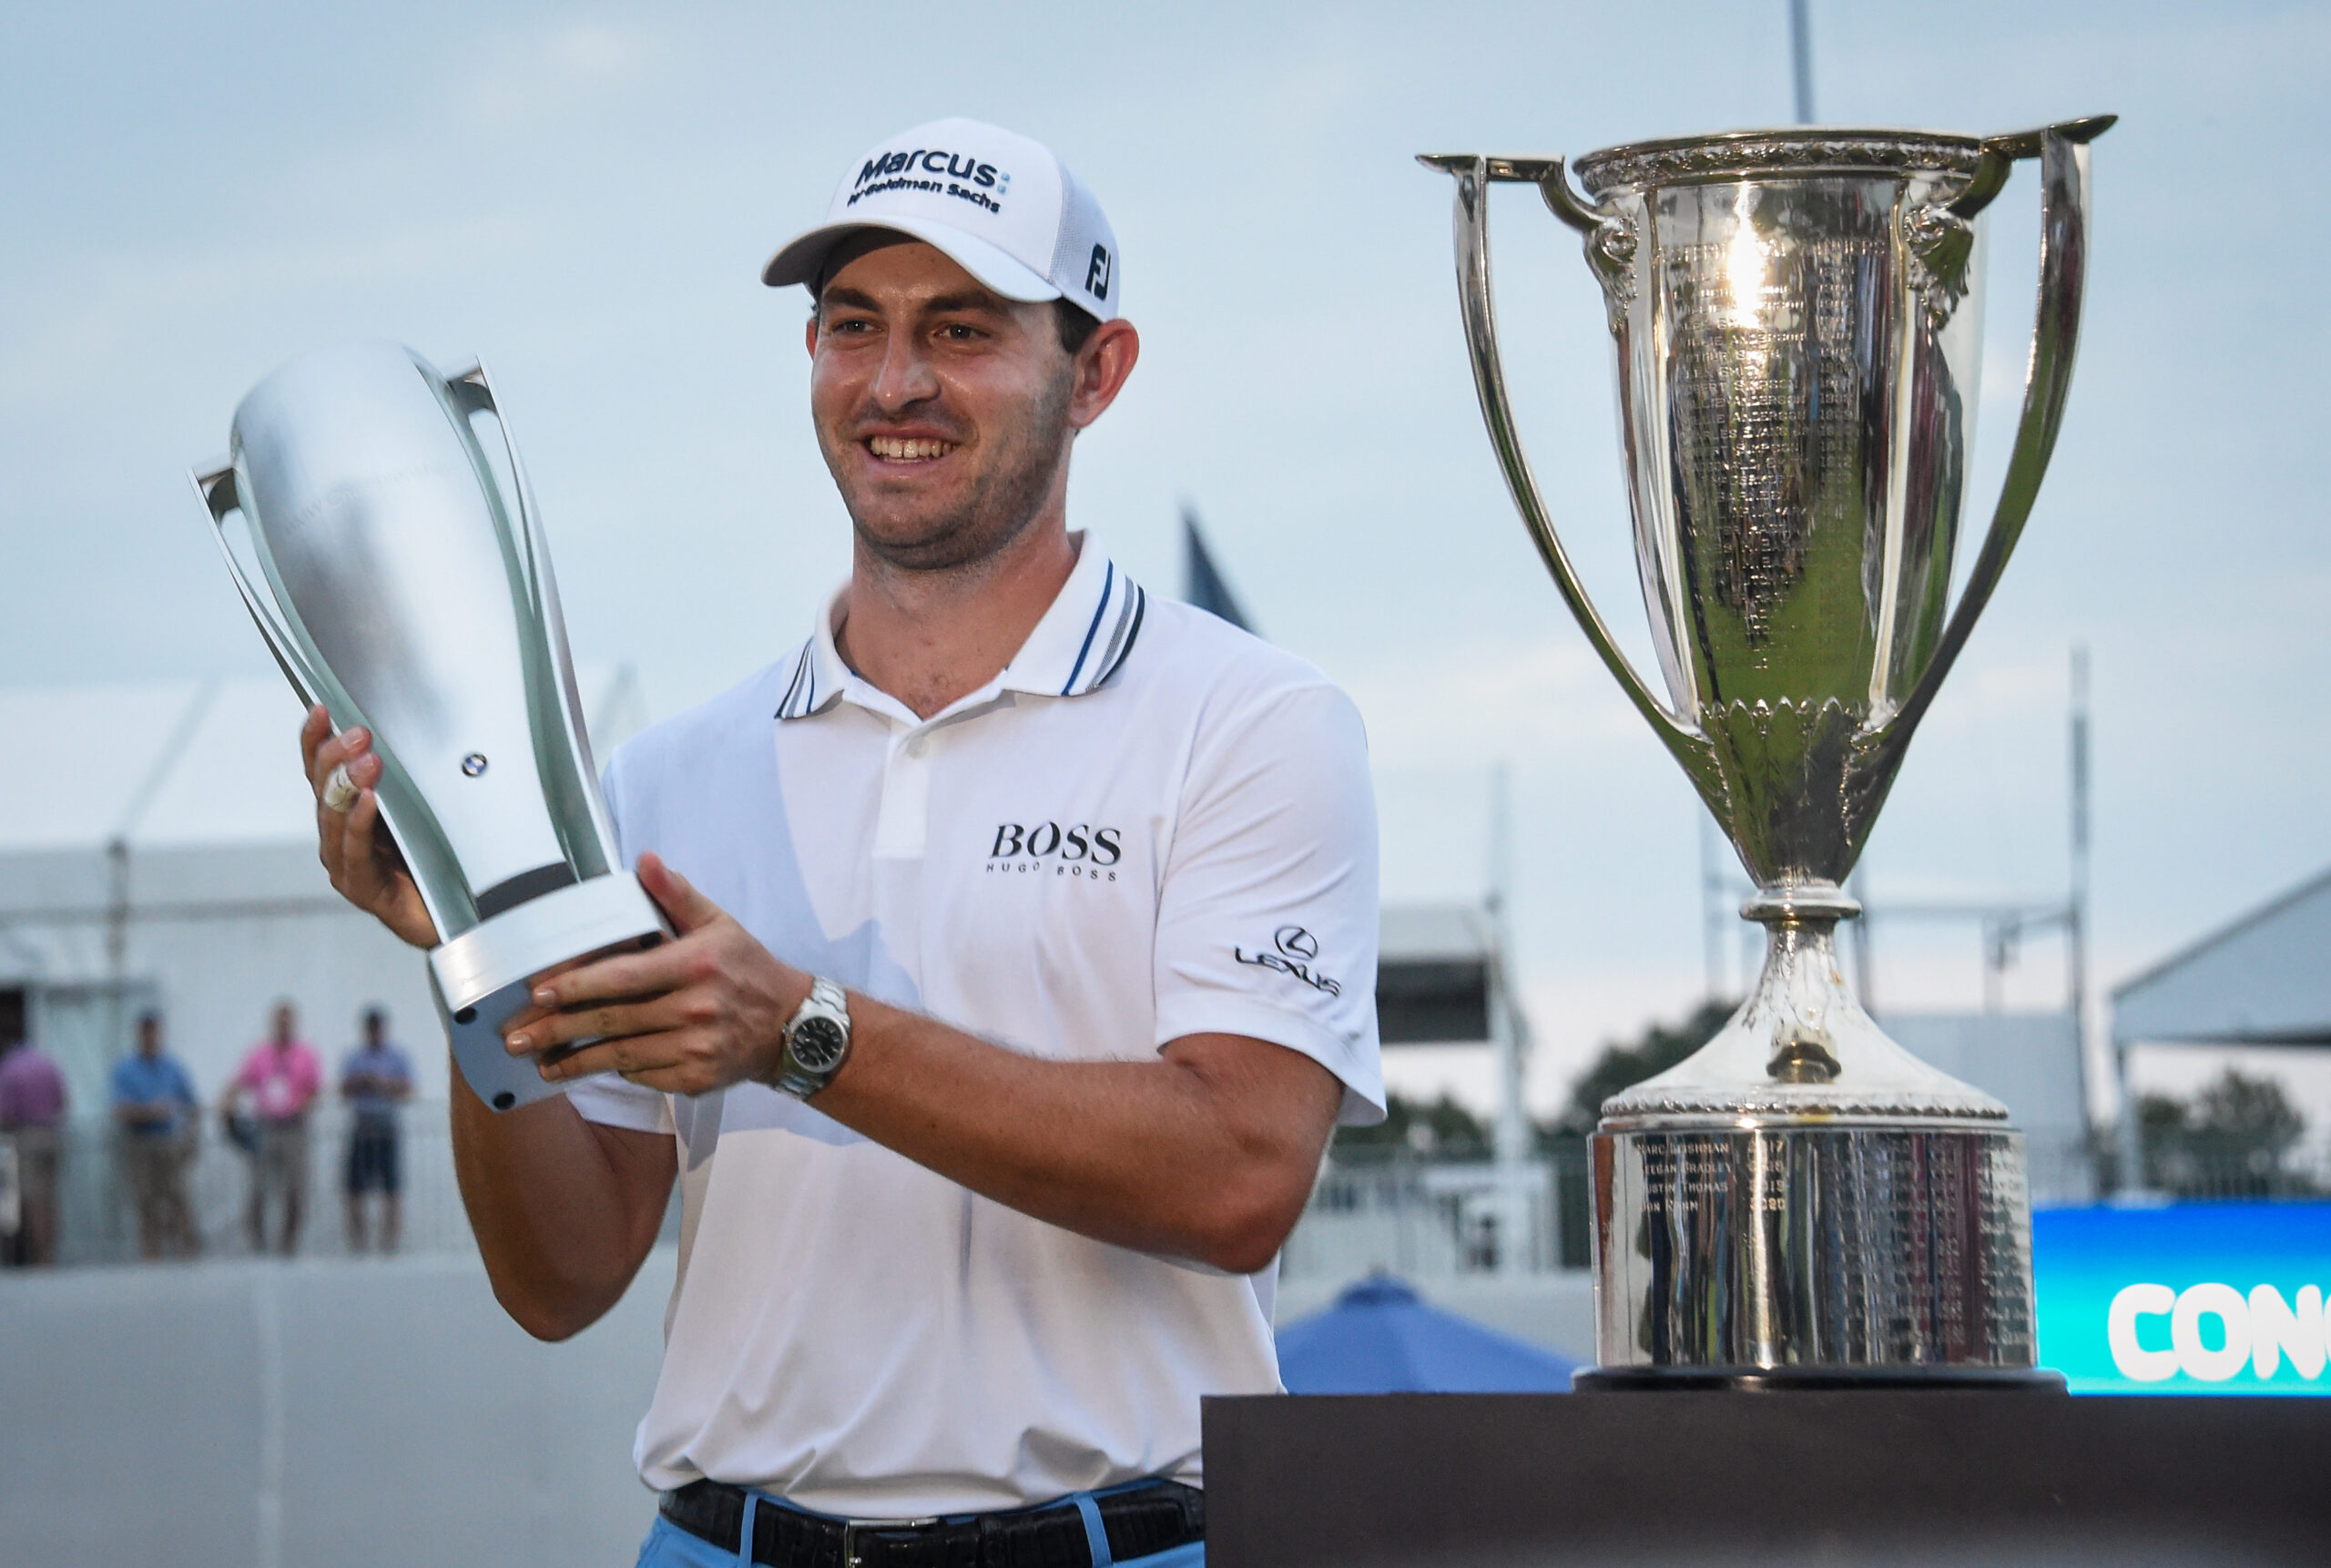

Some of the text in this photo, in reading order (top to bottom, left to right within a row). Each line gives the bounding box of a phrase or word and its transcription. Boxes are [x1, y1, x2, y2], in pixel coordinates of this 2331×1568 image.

[946, 183, 1001, 213] Sachs
[990, 821, 1121, 866] BOSS
[986, 861, 1116, 881] HUGO BOSS
[1235, 946, 1341, 998] LEXUS
[2108, 1282, 2331, 1381] CON
